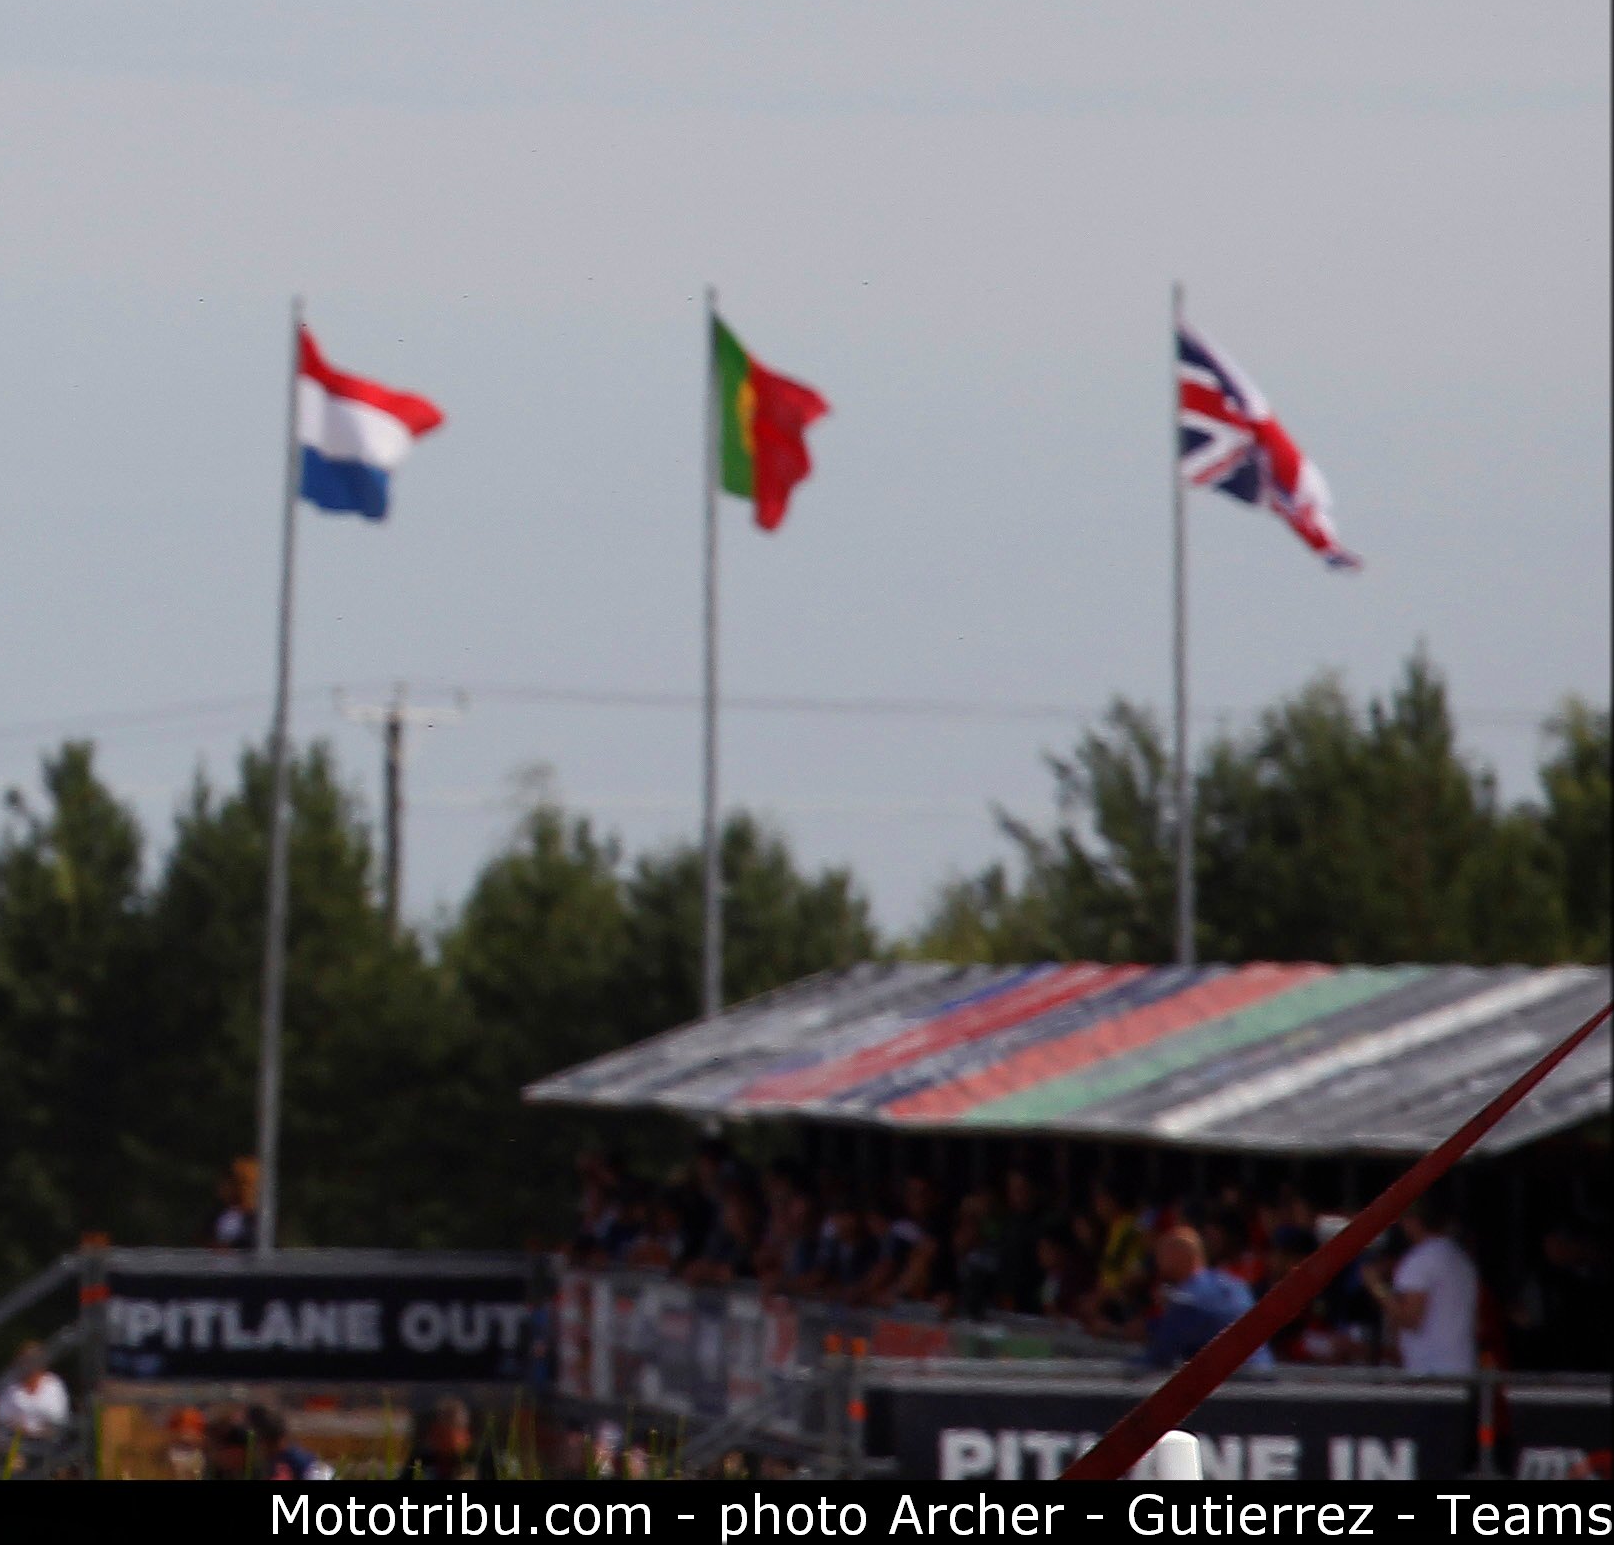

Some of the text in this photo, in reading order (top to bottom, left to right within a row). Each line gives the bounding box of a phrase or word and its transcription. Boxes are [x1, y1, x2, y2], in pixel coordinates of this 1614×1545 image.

[124, 1298, 527, 1351] PITLANE OUT
[938, 1429, 1418, 1480] PITNE IN
